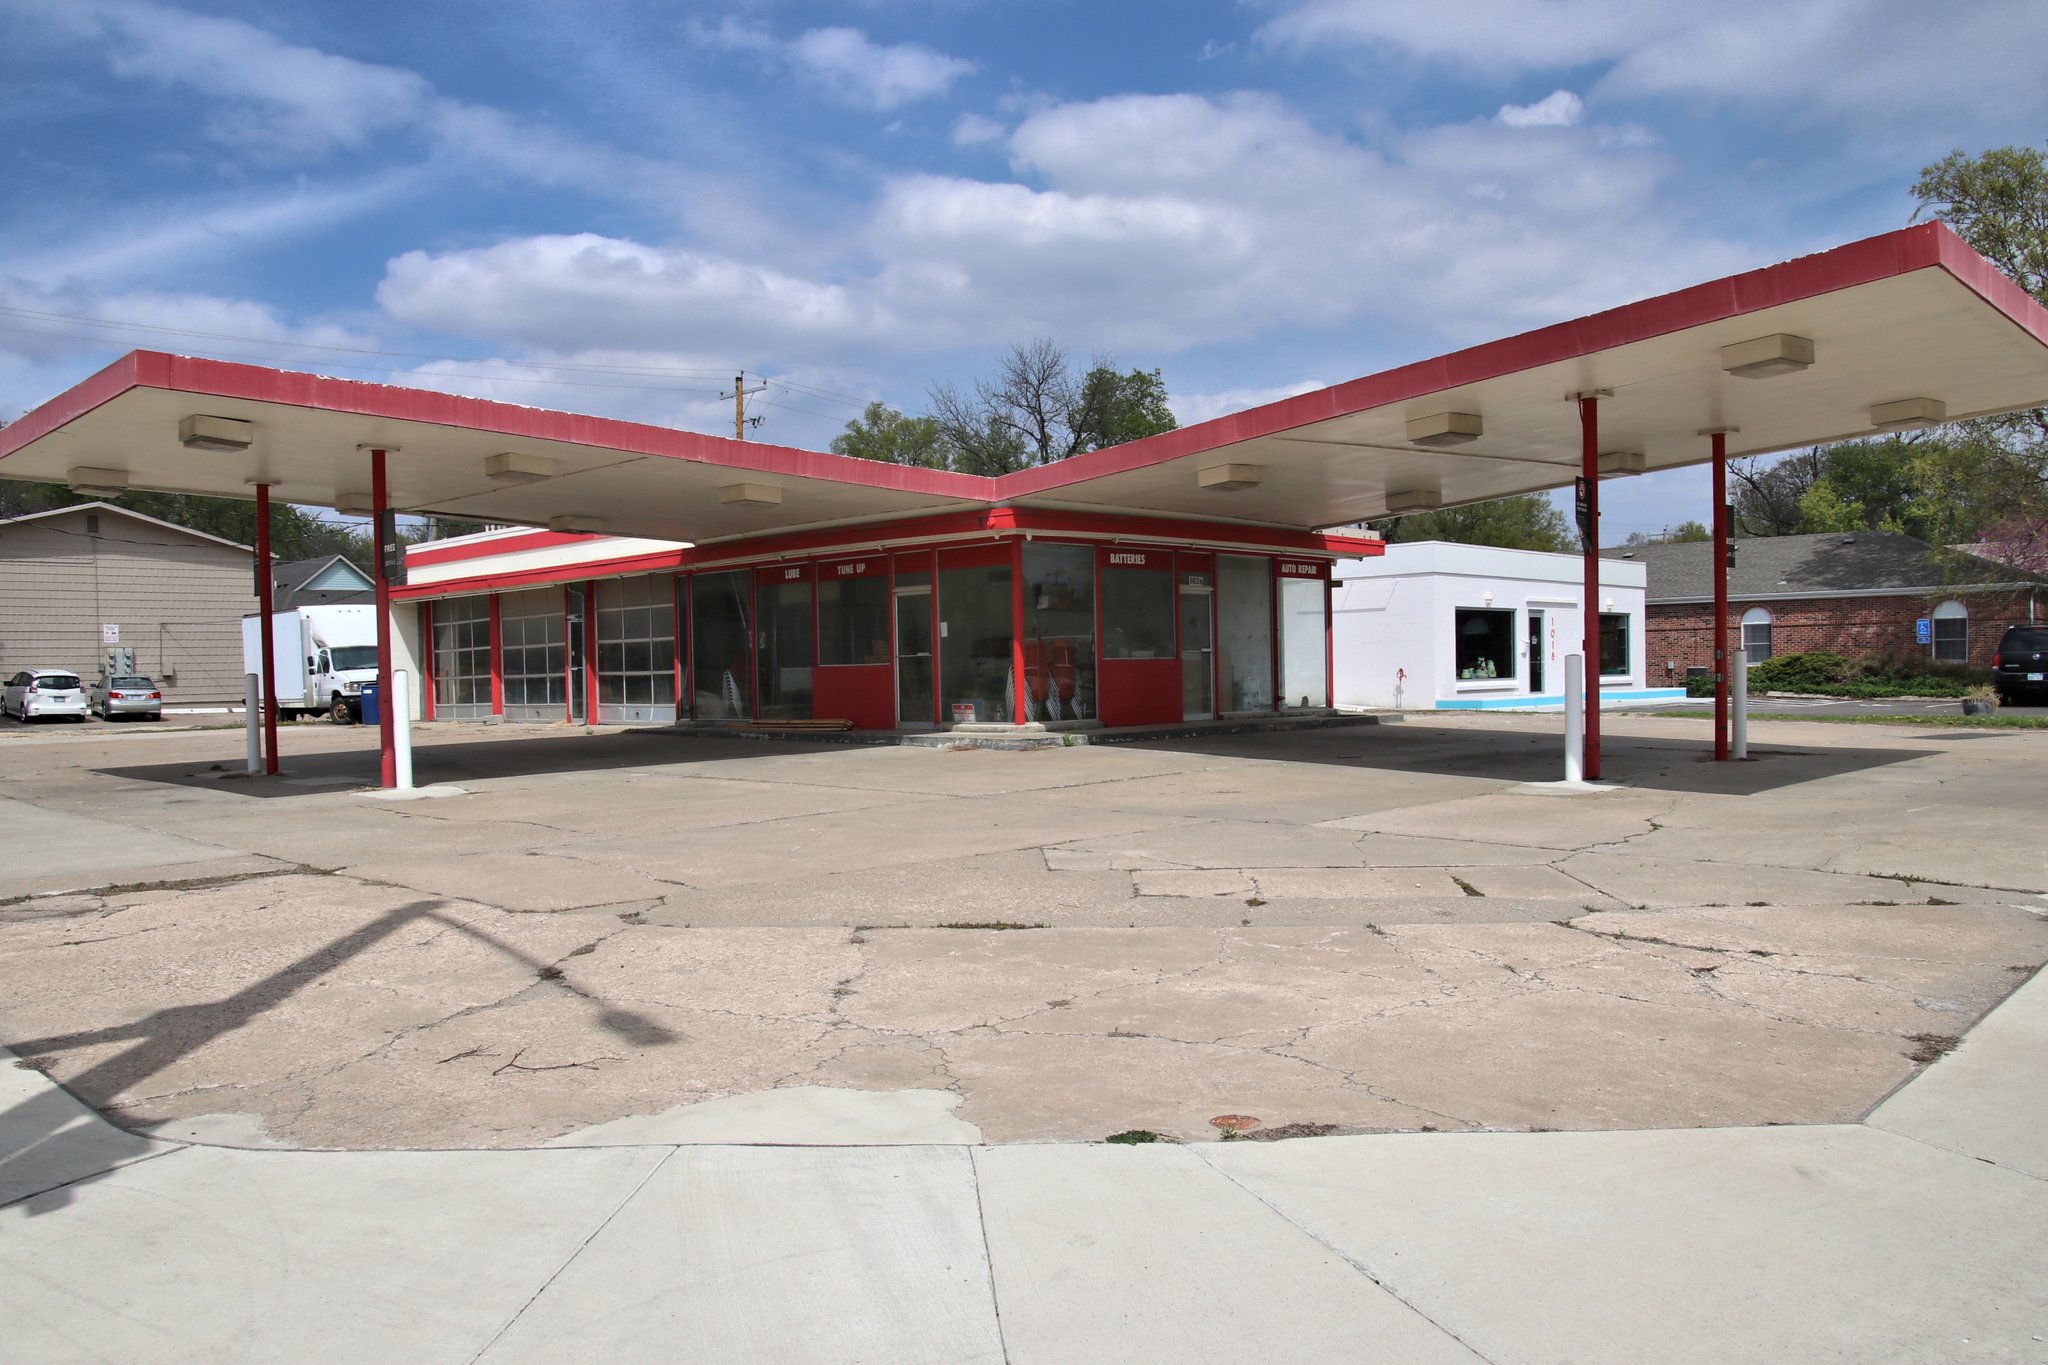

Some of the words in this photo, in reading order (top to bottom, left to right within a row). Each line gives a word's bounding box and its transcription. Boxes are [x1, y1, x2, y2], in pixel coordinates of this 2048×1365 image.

[384, 543, 396, 553] FREE
[1110, 553, 1145, 564] BATTERIES
[785, 568, 800, 579] LUBE
[837, 564, 854, 575] TUNE
[856, 563, 866, 574] UP
[1281, 563, 1297, 573] AUTO
[1298, 564, 1317, 575] REPAIR
